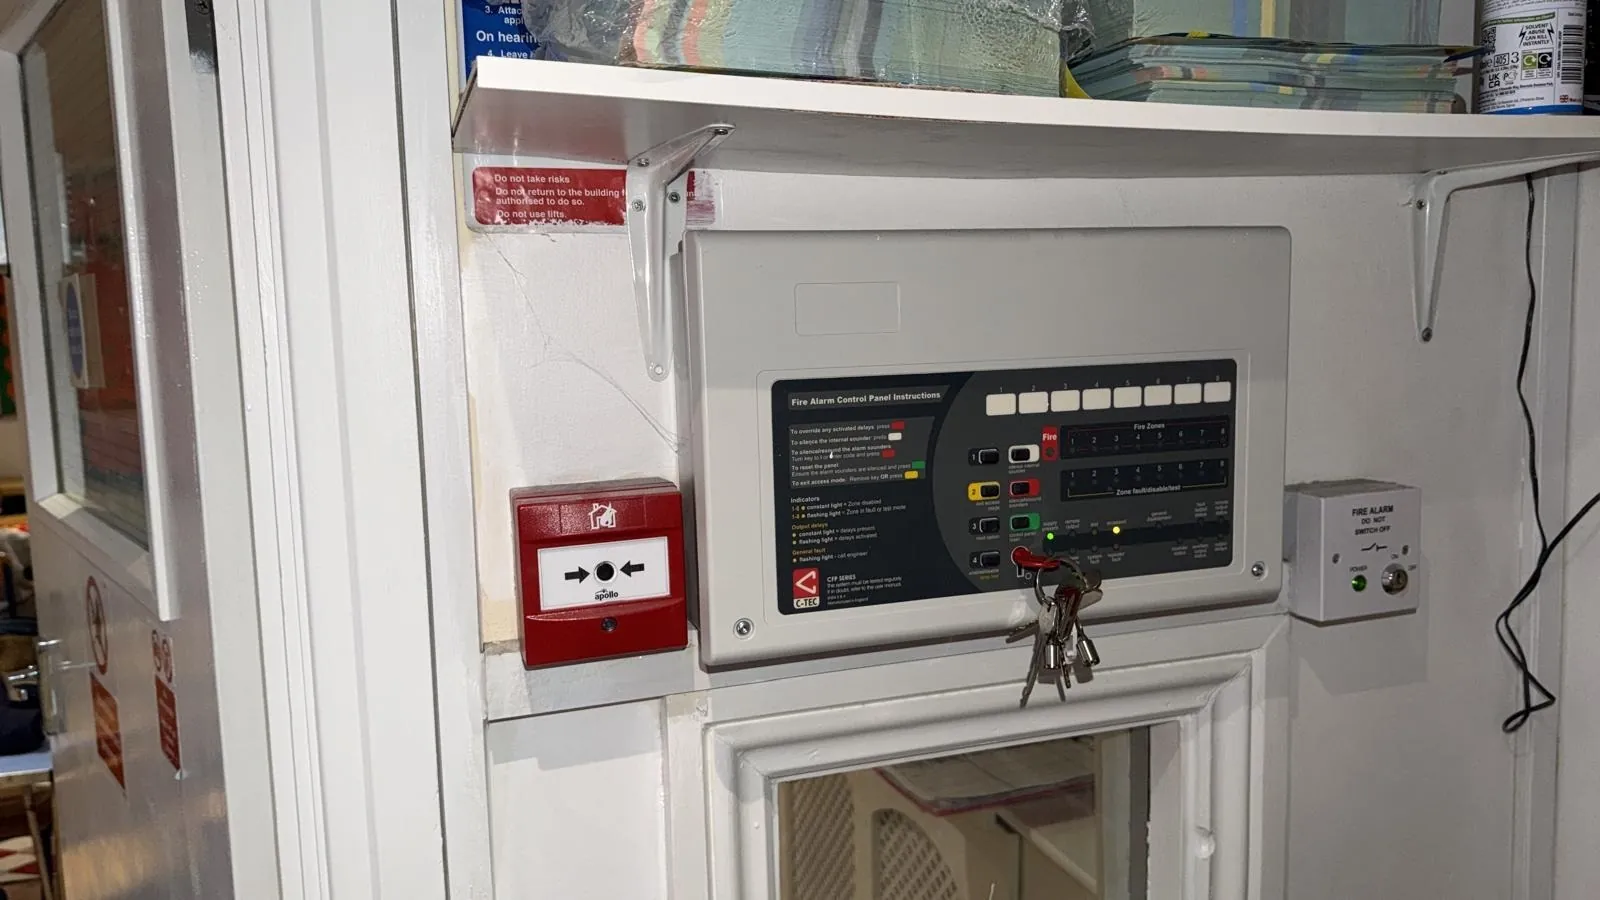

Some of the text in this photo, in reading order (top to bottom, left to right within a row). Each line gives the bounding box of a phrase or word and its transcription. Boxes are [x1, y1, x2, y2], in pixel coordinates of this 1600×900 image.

[485, 6, 522, 15] 3. Attac
[504, 17, 525, 25] appl
[476, 30, 540, 43] On hearin
[501, 50, 527, 58] Leave
[1511, 52, 1519, 63] 3
[1489, 73, 1500, 81] UK
[494, 174, 507, 182] Do
[527, 175, 545, 183] take
[496, 187, 508, 195] Do
[584, 189, 620, 198] building
[497, 210, 510, 218] Do
[512, 210, 527, 218] not
[547, 210, 566, 218] lifts.
[791, 391, 941, 406] Fire Alarm Control Panel Instructions
[832, 425, 856, 433] activated
[857, 424, 874, 432] delays
[791, 496, 820, 504] Indicators
[1352, 505, 1394, 517] FIRE ALARM
[1355, 525, 1391, 536] SWITCH OFF
[799, 537, 820, 545] flashing
[792, 548, 813, 556] General
[822, 553, 833, 561] light
[594, 591, 619, 602] apollo
[795, 598, 818, 608] C-TEC
